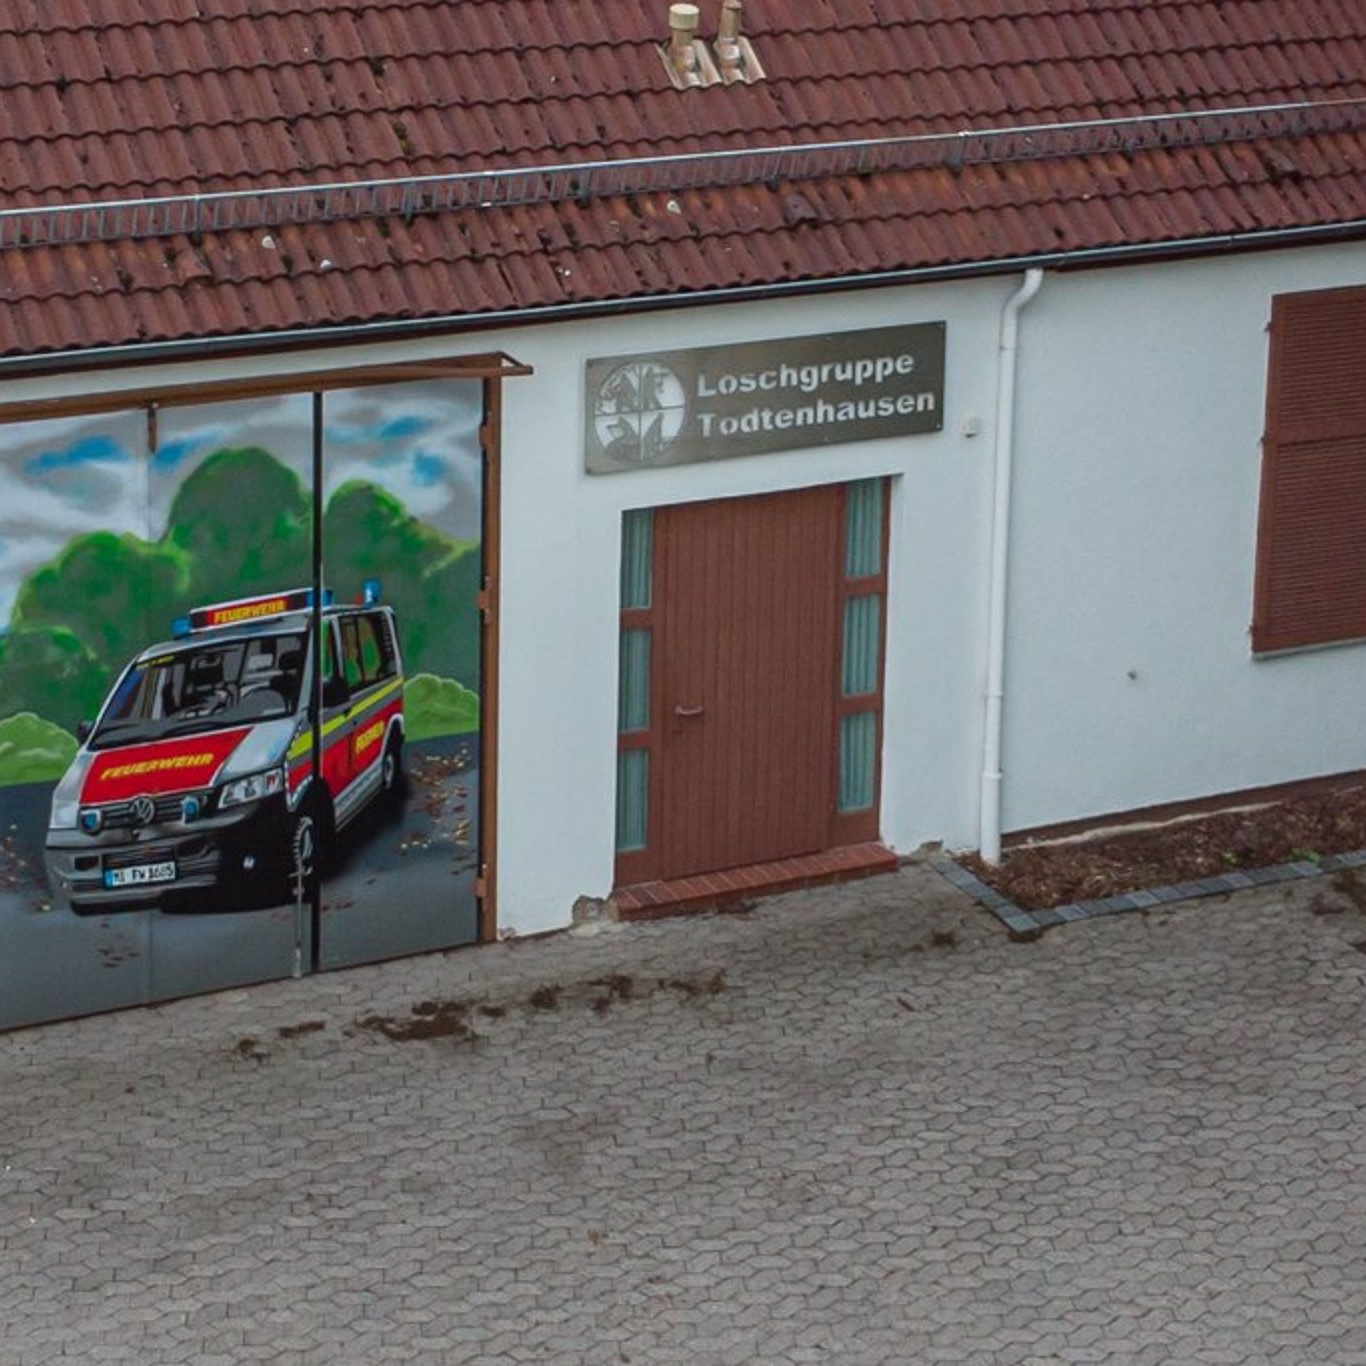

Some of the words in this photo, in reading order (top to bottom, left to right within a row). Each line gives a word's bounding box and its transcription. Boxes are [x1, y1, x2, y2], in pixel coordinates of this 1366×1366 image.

[697, 391, 935, 437] Todtenhausen
[215, 600, 286, 624] FEUERWEHR
[100, 753, 214, 780] FEUERWEHR
